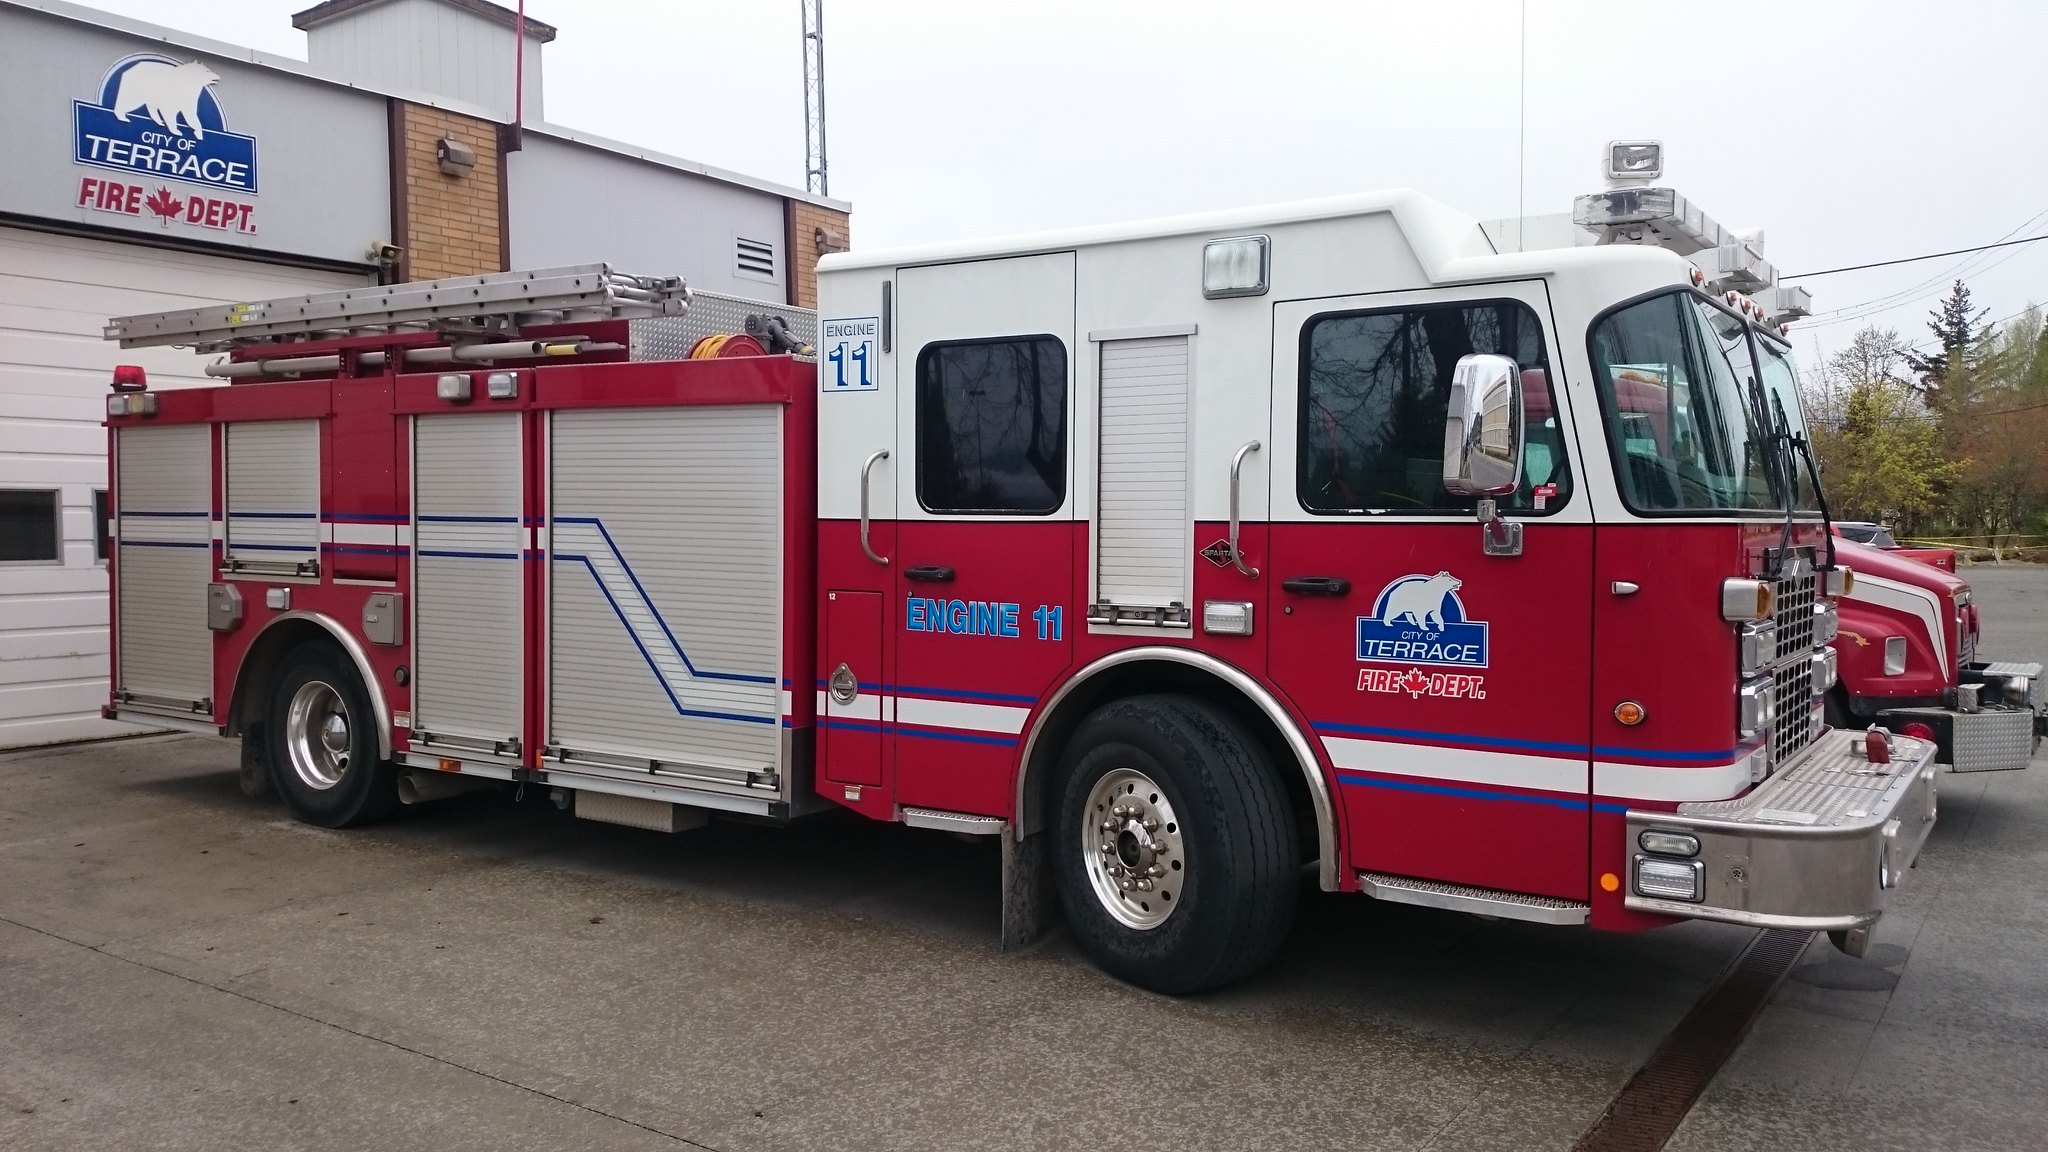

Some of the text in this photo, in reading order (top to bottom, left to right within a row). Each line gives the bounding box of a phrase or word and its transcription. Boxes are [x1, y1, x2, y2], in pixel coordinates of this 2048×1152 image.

[141, 131, 197, 151] CITY OF
[85, 134, 249, 186] TERRACE
[77, 177, 257, 233] FIRE DEPT.
[826, 323, 875, 337] ENGINE
[828, 340, 872, 386] 11
[1204, 549, 1232, 557] SPARTA
[829, 592, 836, 600] 12
[906, 597, 1063, 641] ENGINE 11
[1401, 631, 1440, 641] CITY OF
[1364, 639, 1480, 662] TERRACE
[1357, 668, 1486, 700] FIRE DEPT.
